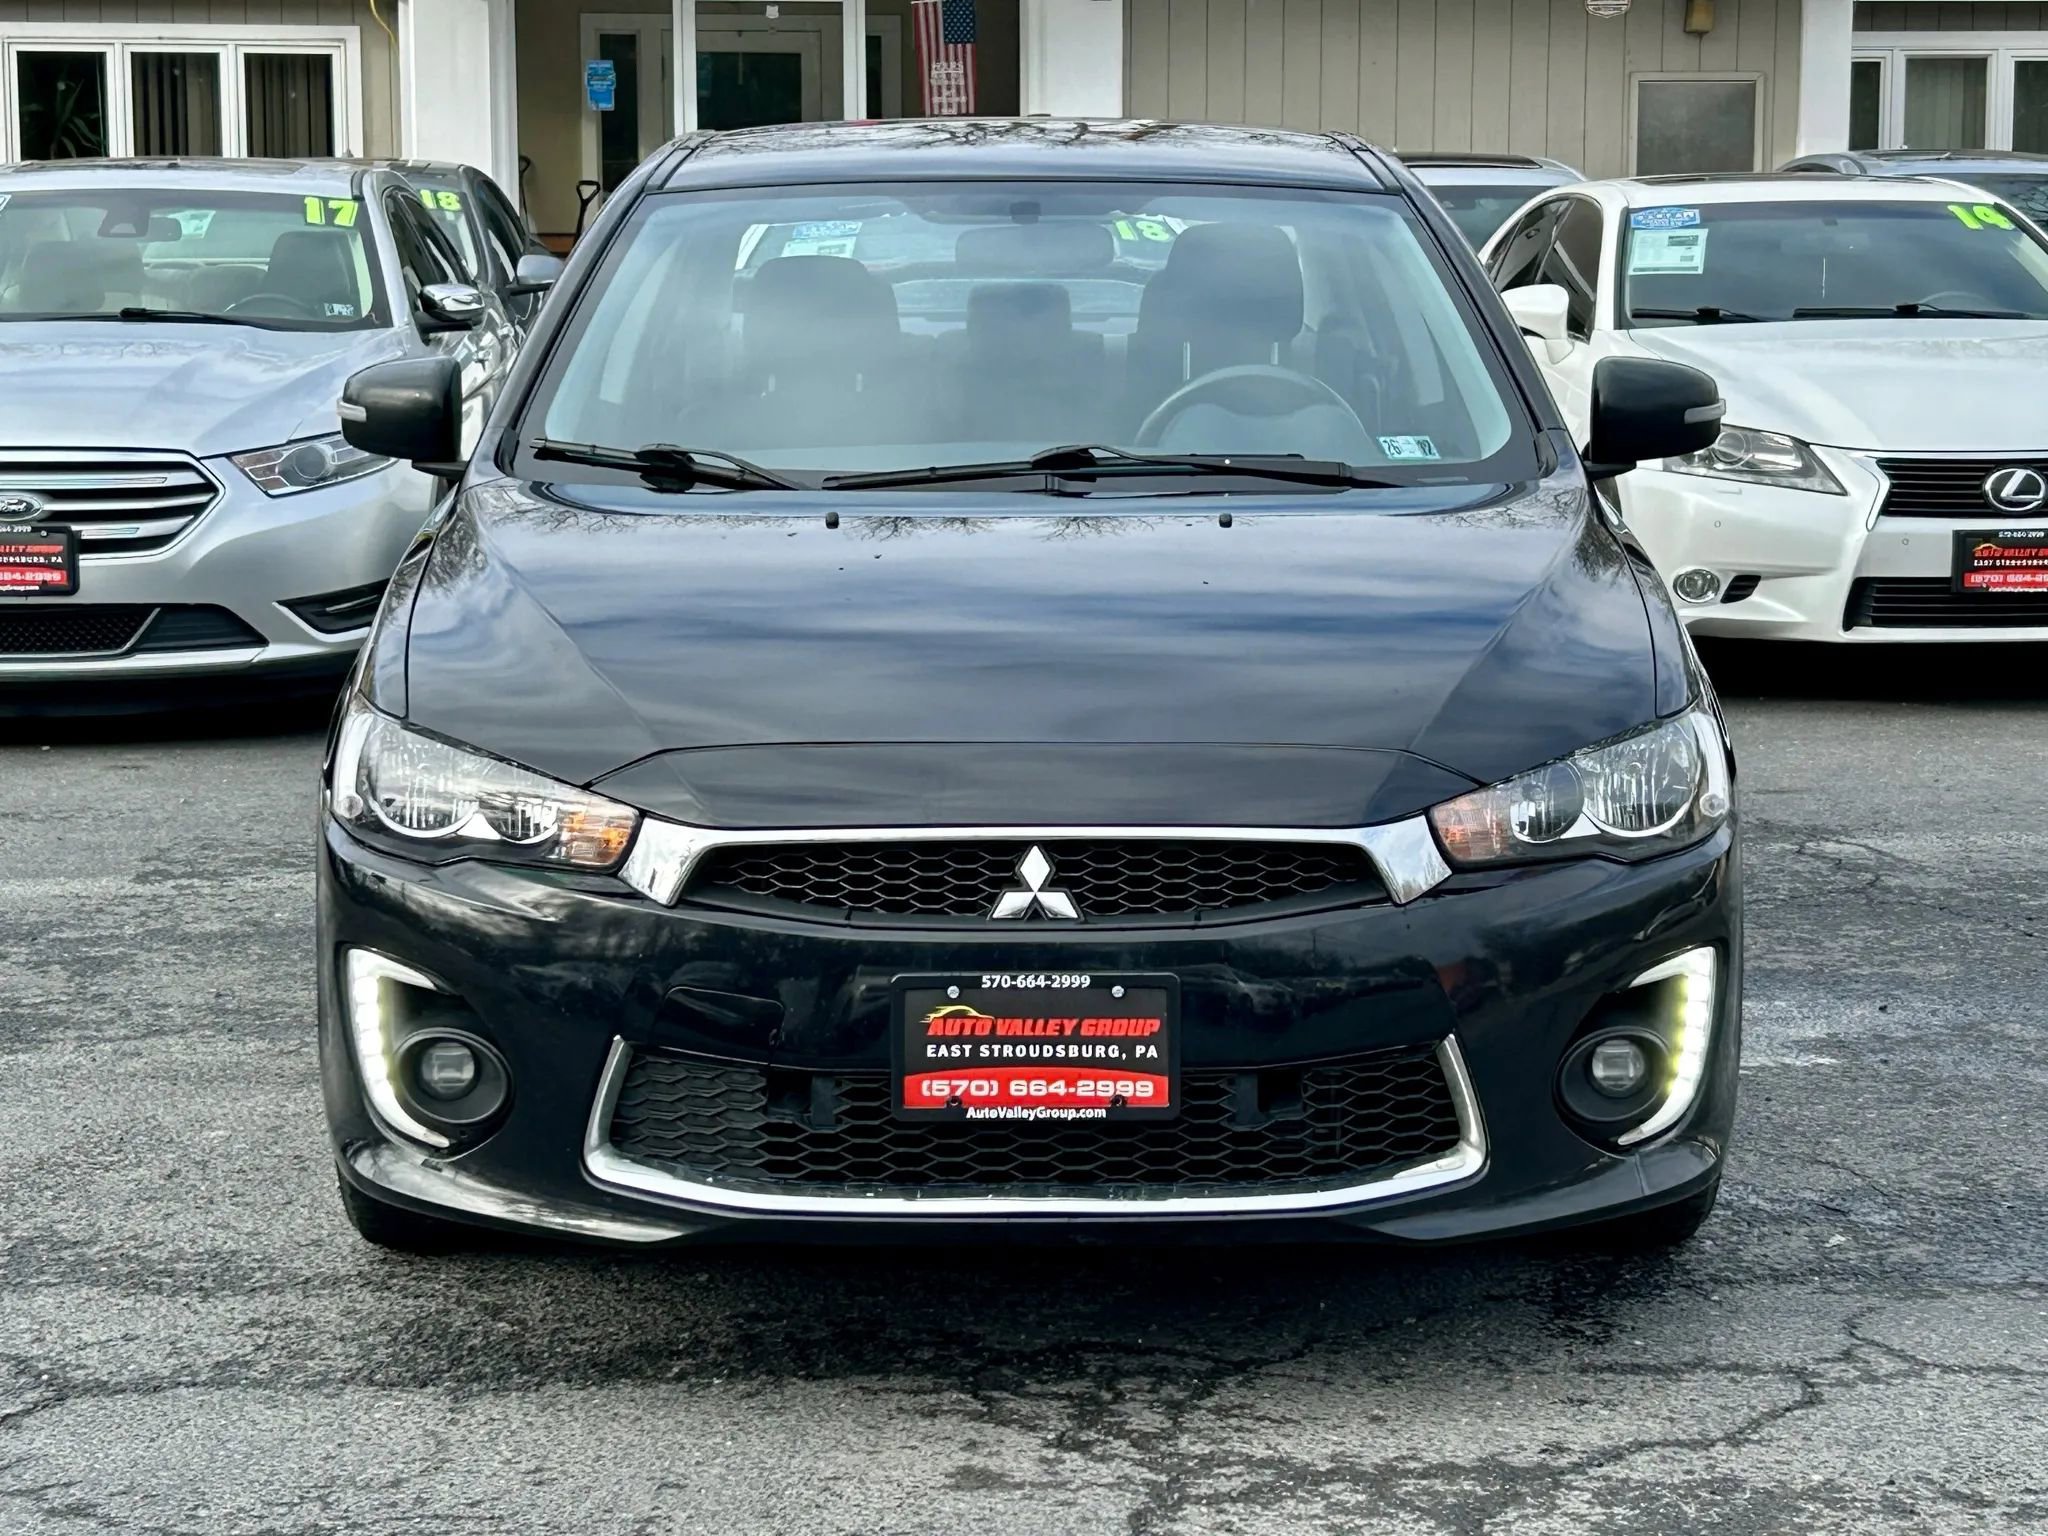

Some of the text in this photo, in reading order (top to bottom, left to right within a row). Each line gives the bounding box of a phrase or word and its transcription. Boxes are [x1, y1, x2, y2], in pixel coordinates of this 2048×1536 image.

[420, 189, 462, 210] 18
[304, 197, 359, 227] 17
[1115, 220, 1170, 241] 18
[981, 975, 1091, 988] 570-664-2999
[927, 1018, 1161, 1036] AUTO VALLEY GROUP
[926, 1044, 1158, 1060] EAST STROUDSBURG, PA
[921, 1079, 1154, 1097] (570) 664-2999
[966, 1106, 1107, 1121] AutoValleyGroup.com
